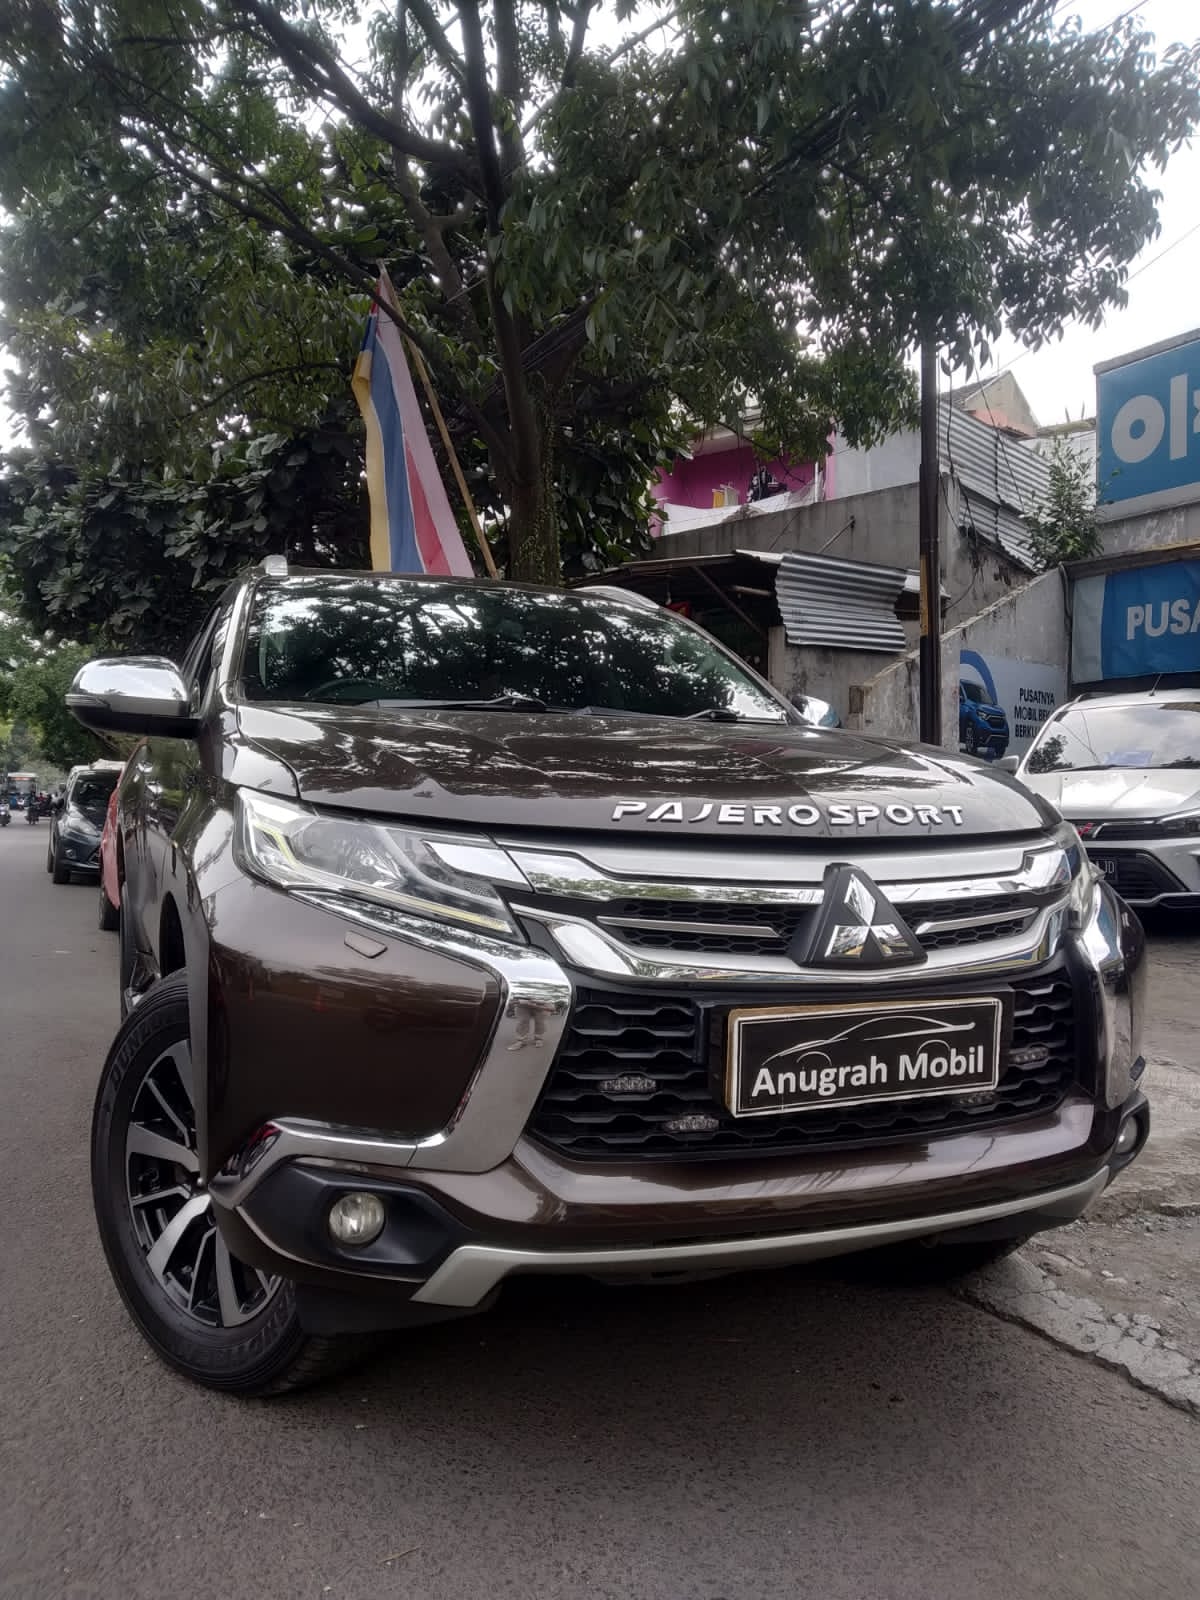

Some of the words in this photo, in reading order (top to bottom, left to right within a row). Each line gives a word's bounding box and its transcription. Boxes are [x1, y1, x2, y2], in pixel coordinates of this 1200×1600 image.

[1111, 374, 1200, 463] ol
[1019, 687, 1055, 705] PUSATNYA
[1014, 705, 1037, 721] MOBIL
[611, 801, 821, 826] PAJERO
[827, 804, 965, 826] SPORT
[751, 1055, 887, 1096] Anugrah
[899, 1045, 984, 1081] Mobil
